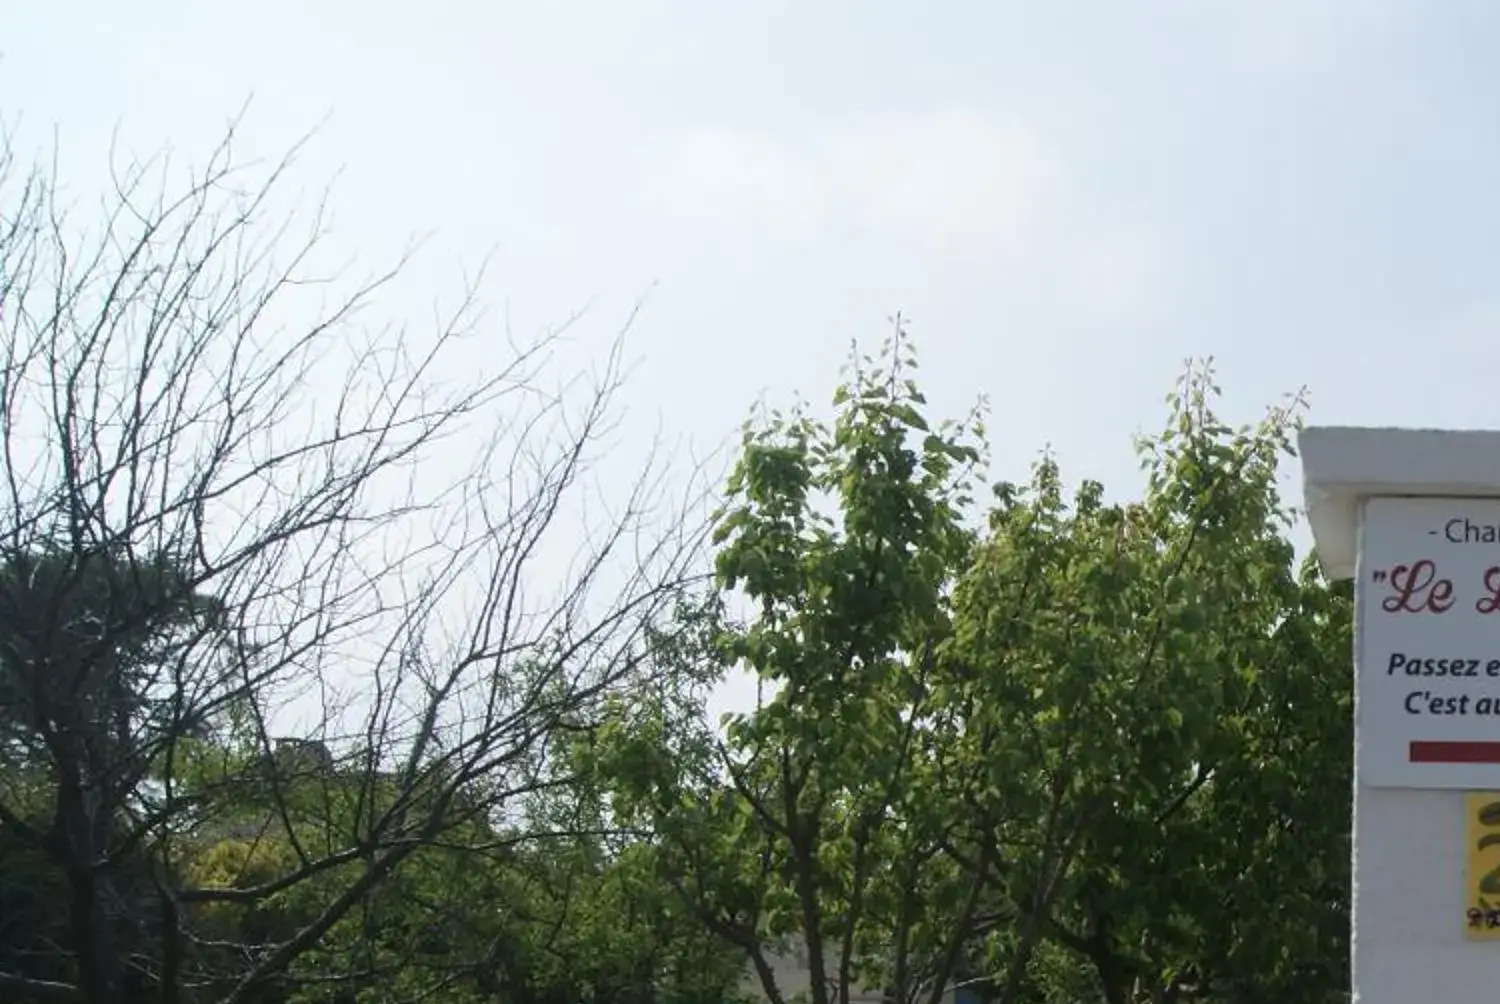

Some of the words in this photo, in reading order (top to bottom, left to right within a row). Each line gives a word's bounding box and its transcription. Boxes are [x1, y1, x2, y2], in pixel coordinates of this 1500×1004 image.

[1372, 559, 1456, 613] "Le
[1387, 653, 1478, 677] Passez
[1405, 691, 1470, 715] C'est
